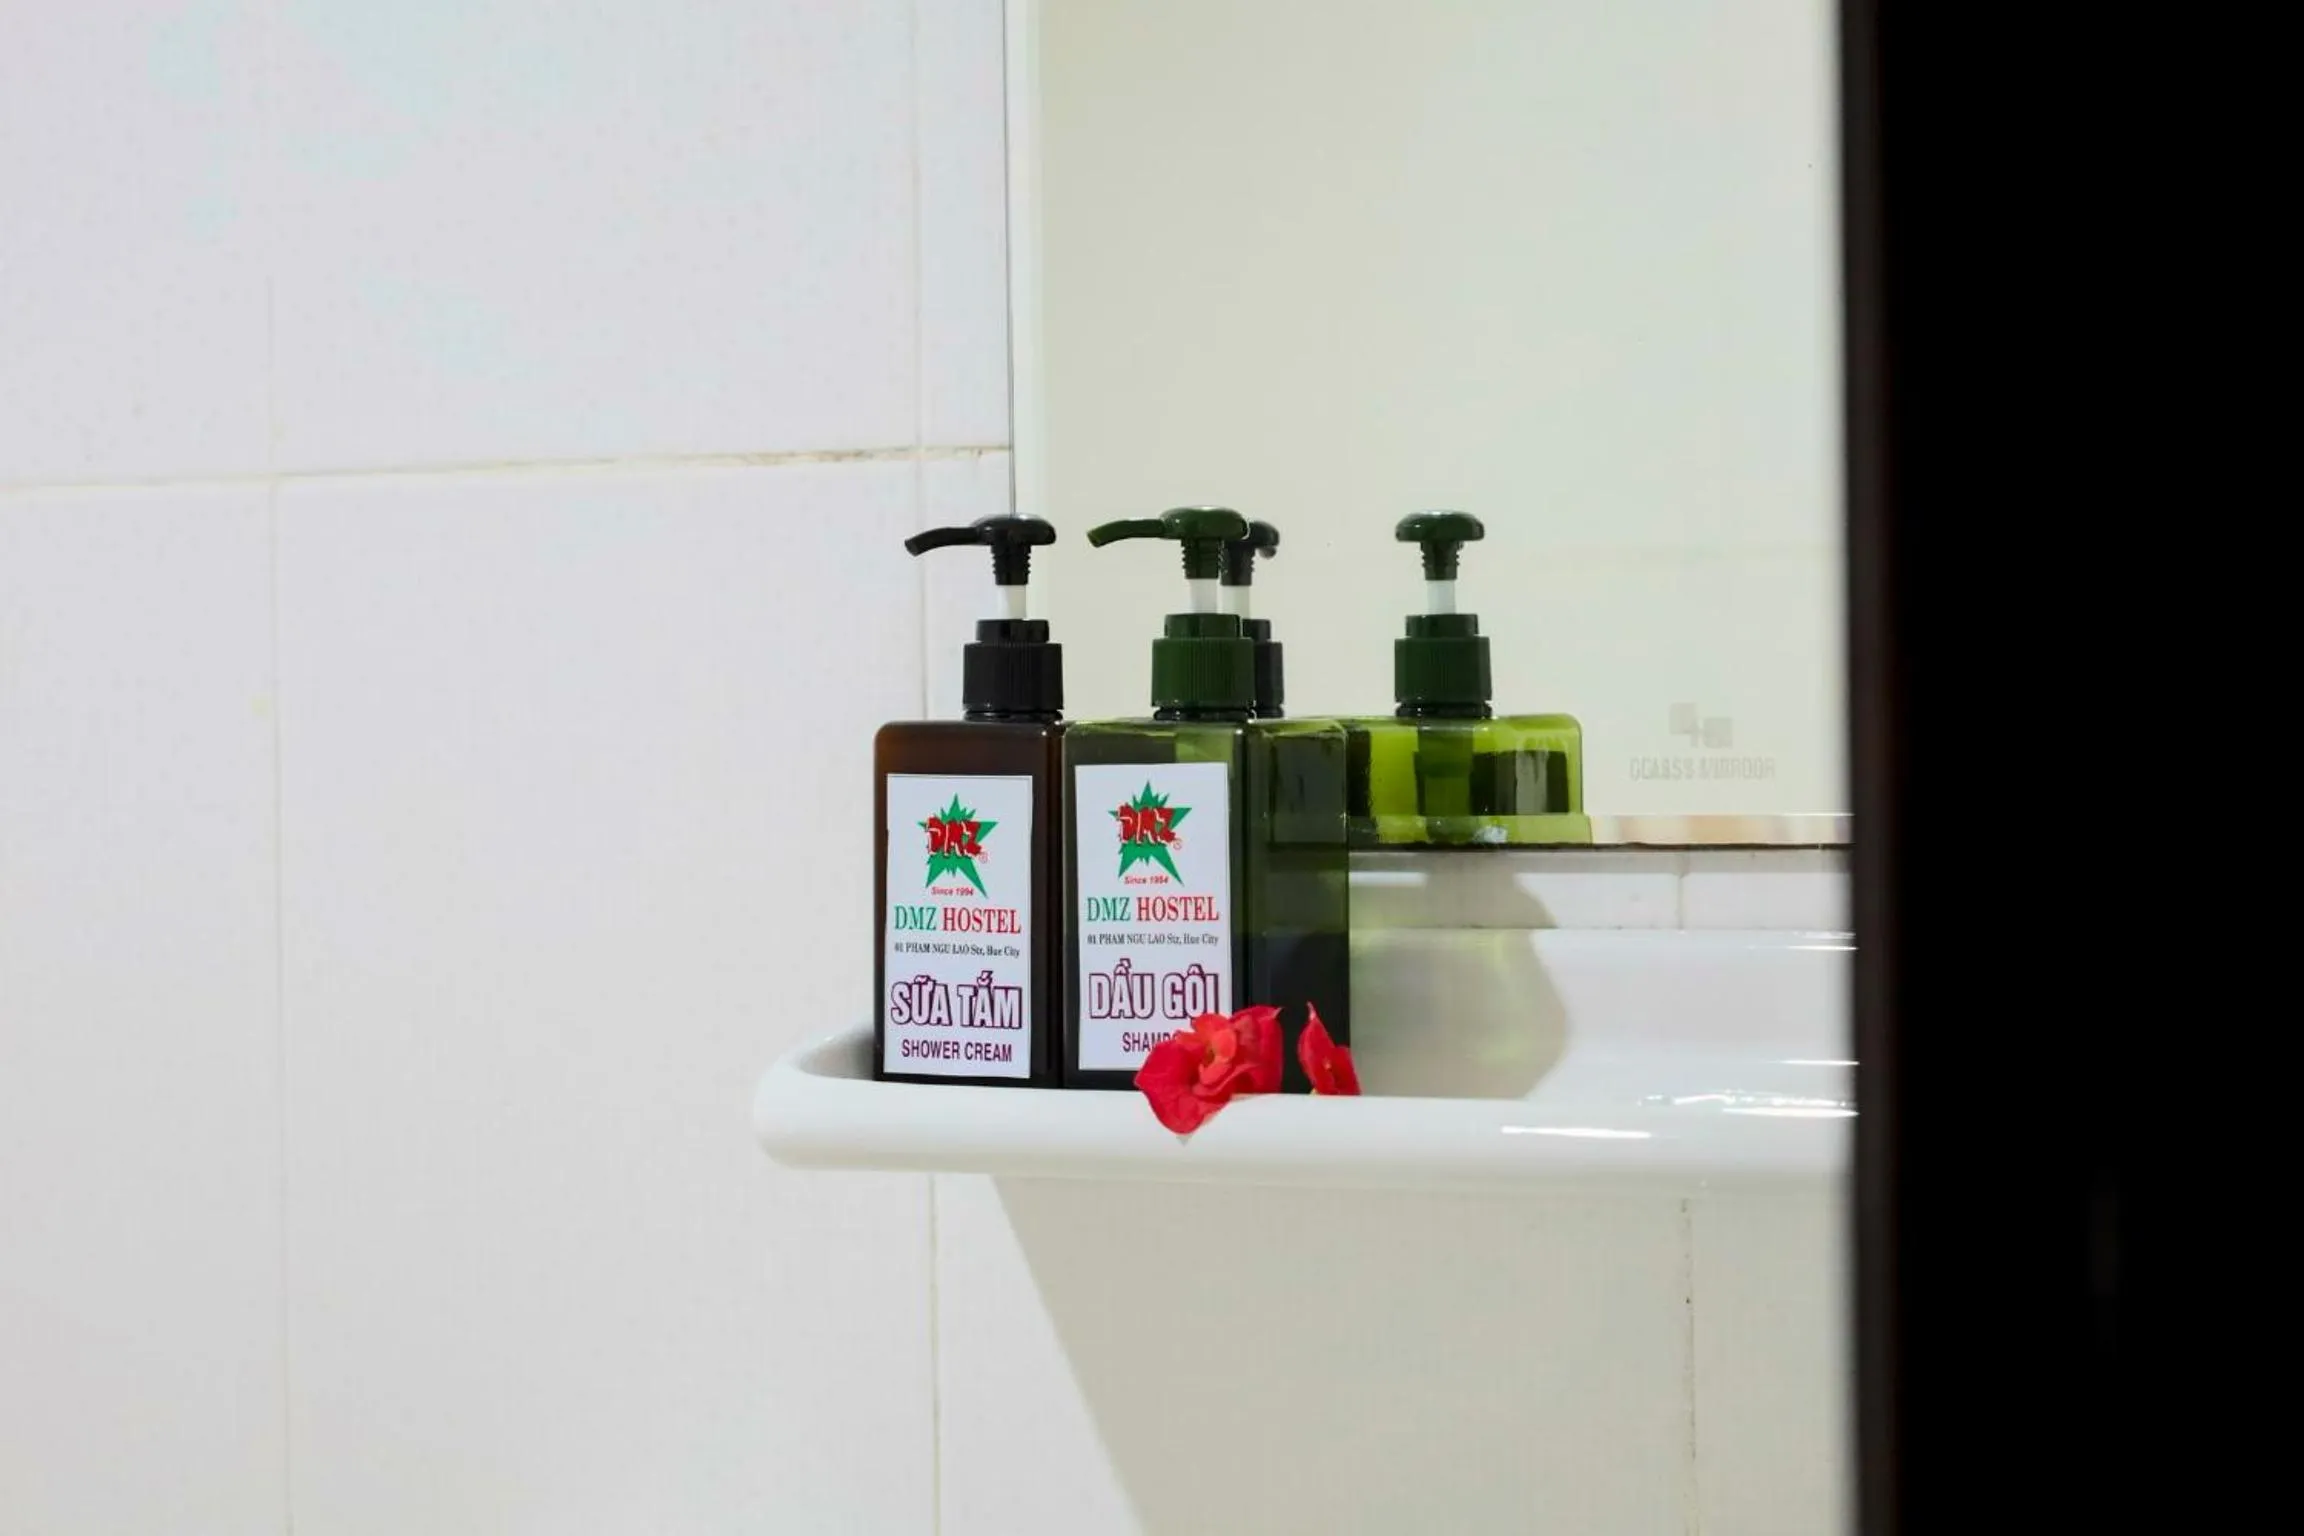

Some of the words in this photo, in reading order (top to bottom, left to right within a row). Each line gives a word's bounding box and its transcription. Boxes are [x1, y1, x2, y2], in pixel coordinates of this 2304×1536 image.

[1117, 803, 1176, 843] DMZ
[926, 816, 984, 857] DMZ
[931, 887, 954, 896] Since
[956, 887, 974, 896] 1994
[1124, 876, 1147, 884] Since
[894, 905, 937, 932] DMZ
[942, 907, 1021, 934] HOSTEL
[1086, 896, 1131, 922] DMZ
[1136, 896, 1220, 922] HOSTEL
[906, 943, 931, 953] PHAM
[932, 944, 951, 954] NGU
[952, 944, 970, 954] LAO
[1004, 946, 1020, 958] City
[1098, 934, 1125, 945] PHAM
[1126, 934, 1145, 945] NGU
[1147, 934, 1166, 945] LAO
[1183, 934, 1200, 945] Hue
[1201, 934, 1219, 946] City
[890, 974, 953, 1027] SỮA
[956, 970, 1023, 1030] TẮM
[1089, 958, 1155, 1019] DẦU
[901, 1039, 960, 1060] SHOWER
[964, 1042, 1012, 1062] CREAM
[1122, 1030, 1183, 1052] SHAM
